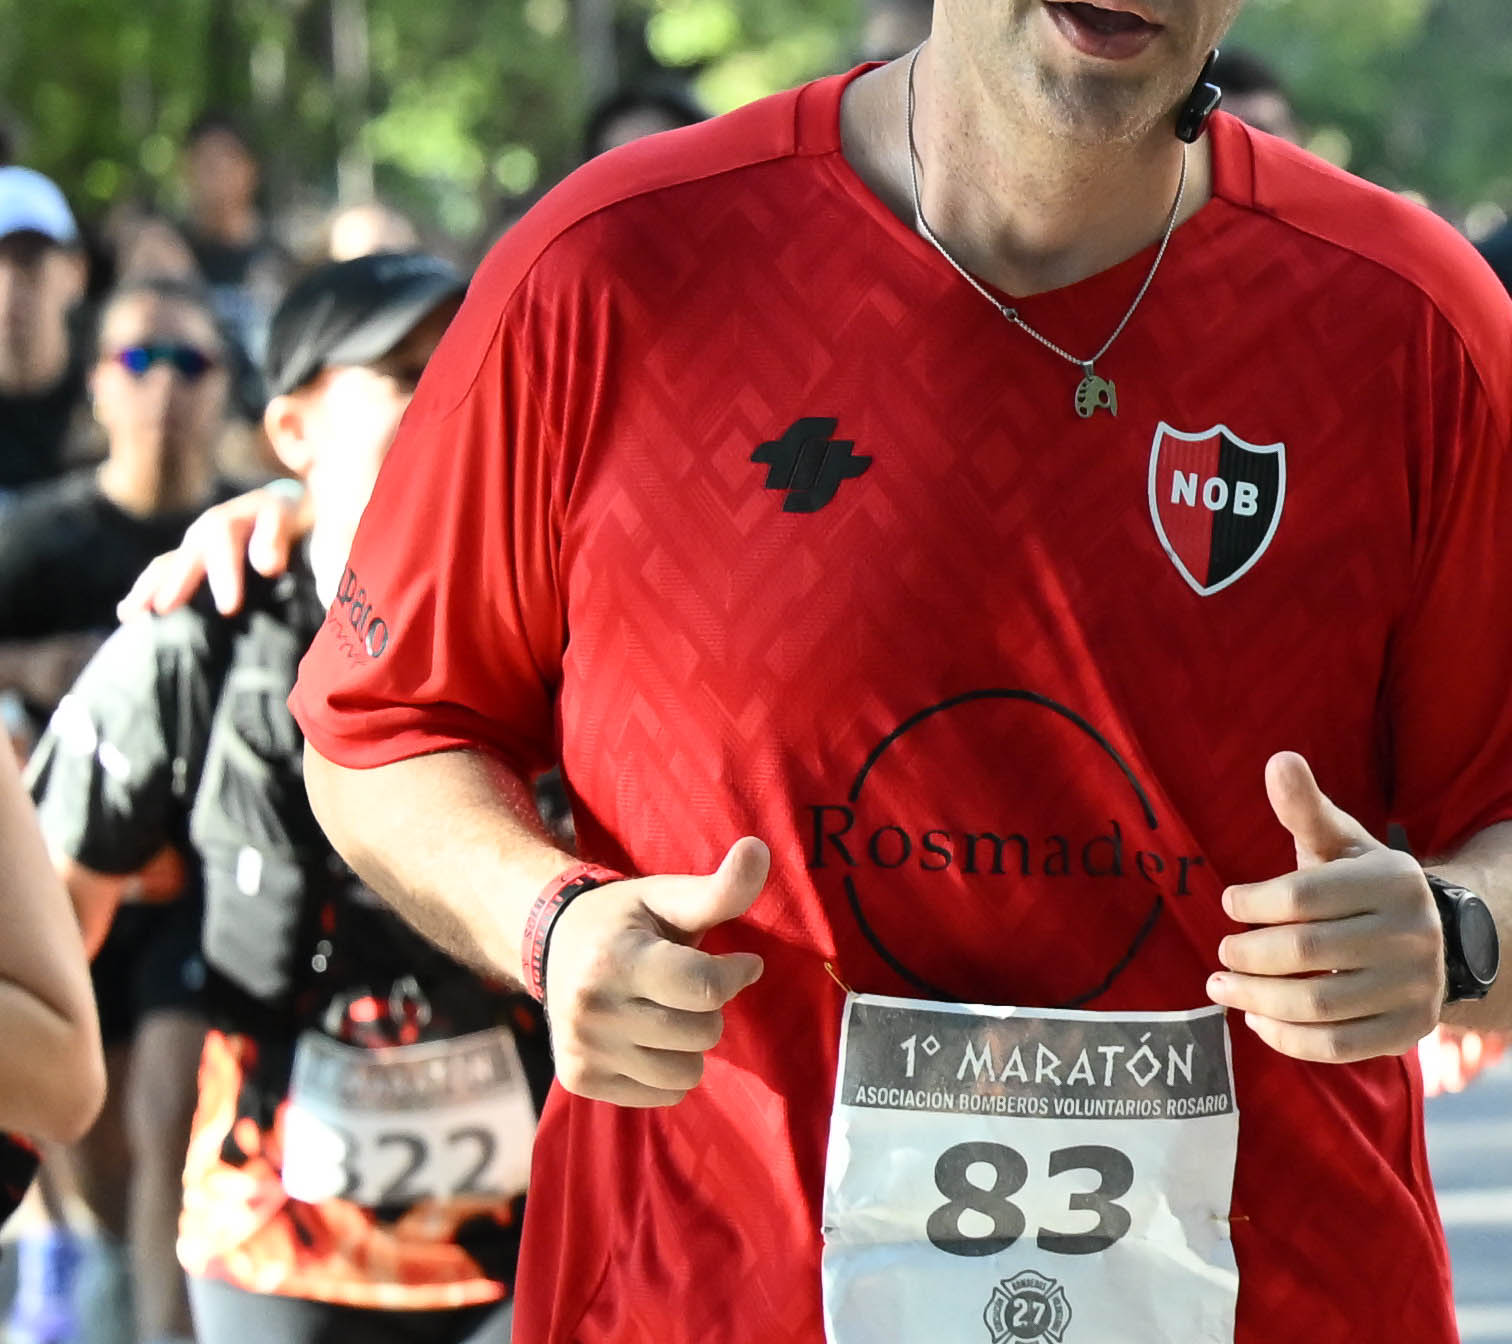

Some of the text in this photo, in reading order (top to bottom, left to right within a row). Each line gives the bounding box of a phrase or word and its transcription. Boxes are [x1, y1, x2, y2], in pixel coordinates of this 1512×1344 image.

[1170, 469, 1259, 516] NOB
[806, 803, 1206, 896] Rosmader
[900, 1031, 1195, 1088] 1° MARATÓN
[958, 1092, 1050, 1115] BOMBEROS
[1053, 1096, 1162, 1117] VOLUNTARIOS
[1166, 1092, 1229, 1116] ROSARIO
[925, 1140, 1136, 1257] 83
[1013, 1297, 1046, 1327] 27
